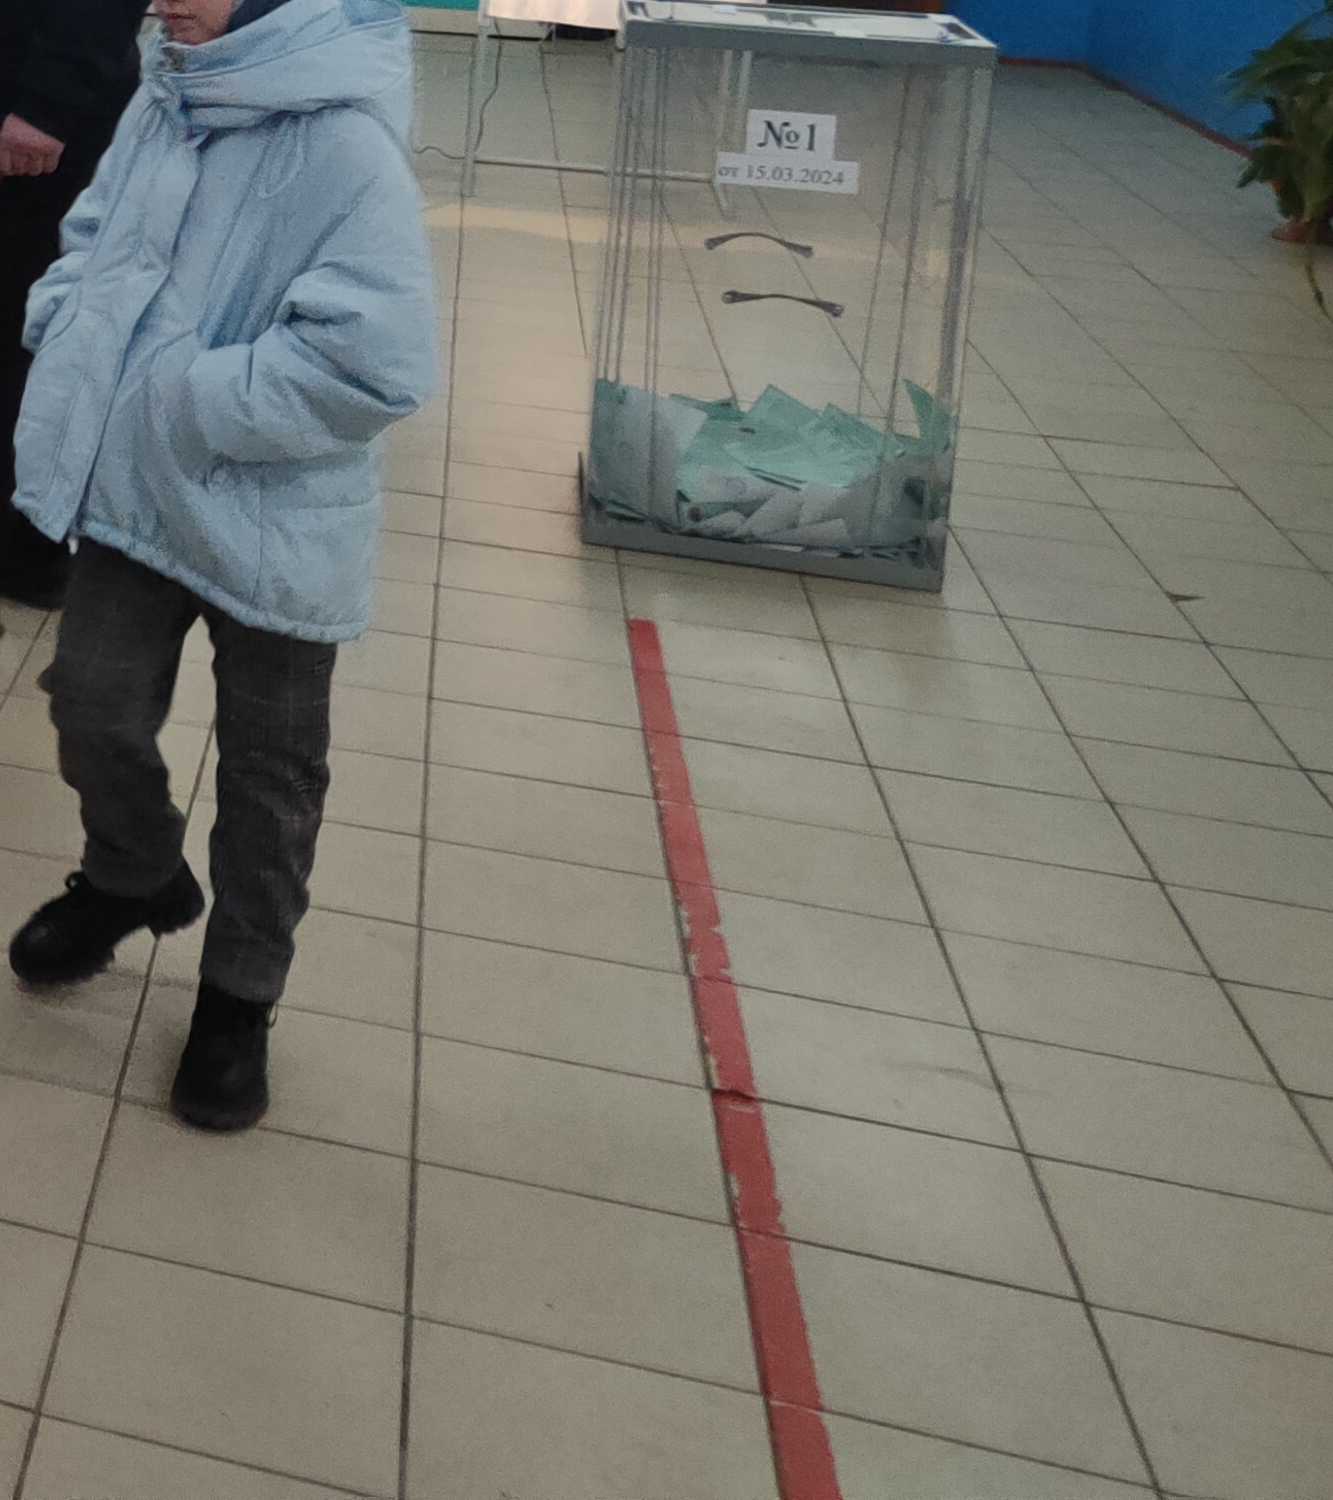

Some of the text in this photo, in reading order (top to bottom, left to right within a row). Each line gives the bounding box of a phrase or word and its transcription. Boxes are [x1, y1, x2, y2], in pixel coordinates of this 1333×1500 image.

[756, 120, 817, 152] №1
[717, 164, 845, 186] от 15.03.2024
